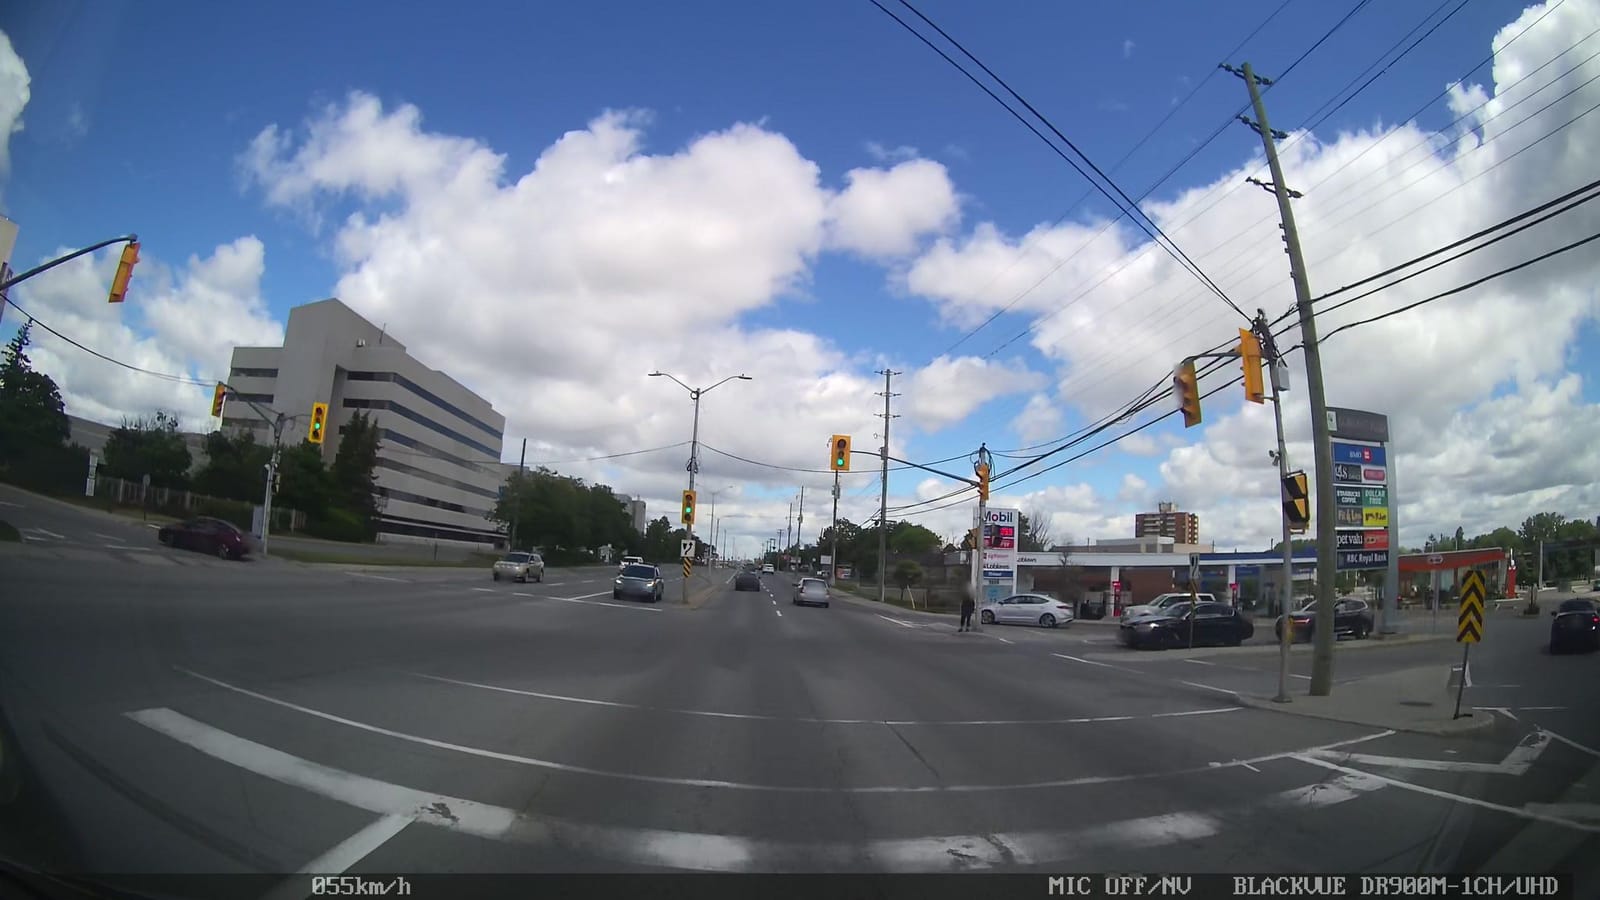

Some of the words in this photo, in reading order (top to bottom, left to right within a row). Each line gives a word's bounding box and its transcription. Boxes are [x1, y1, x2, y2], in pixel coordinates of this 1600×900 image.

[1336, 533, 1348, 547] pet
[1348, 533, 1363, 545] valu
[1346, 553, 1358, 563] RBC
[1359, 553, 1374, 565] Royal
[1374, 552, 1387, 562] Bank
